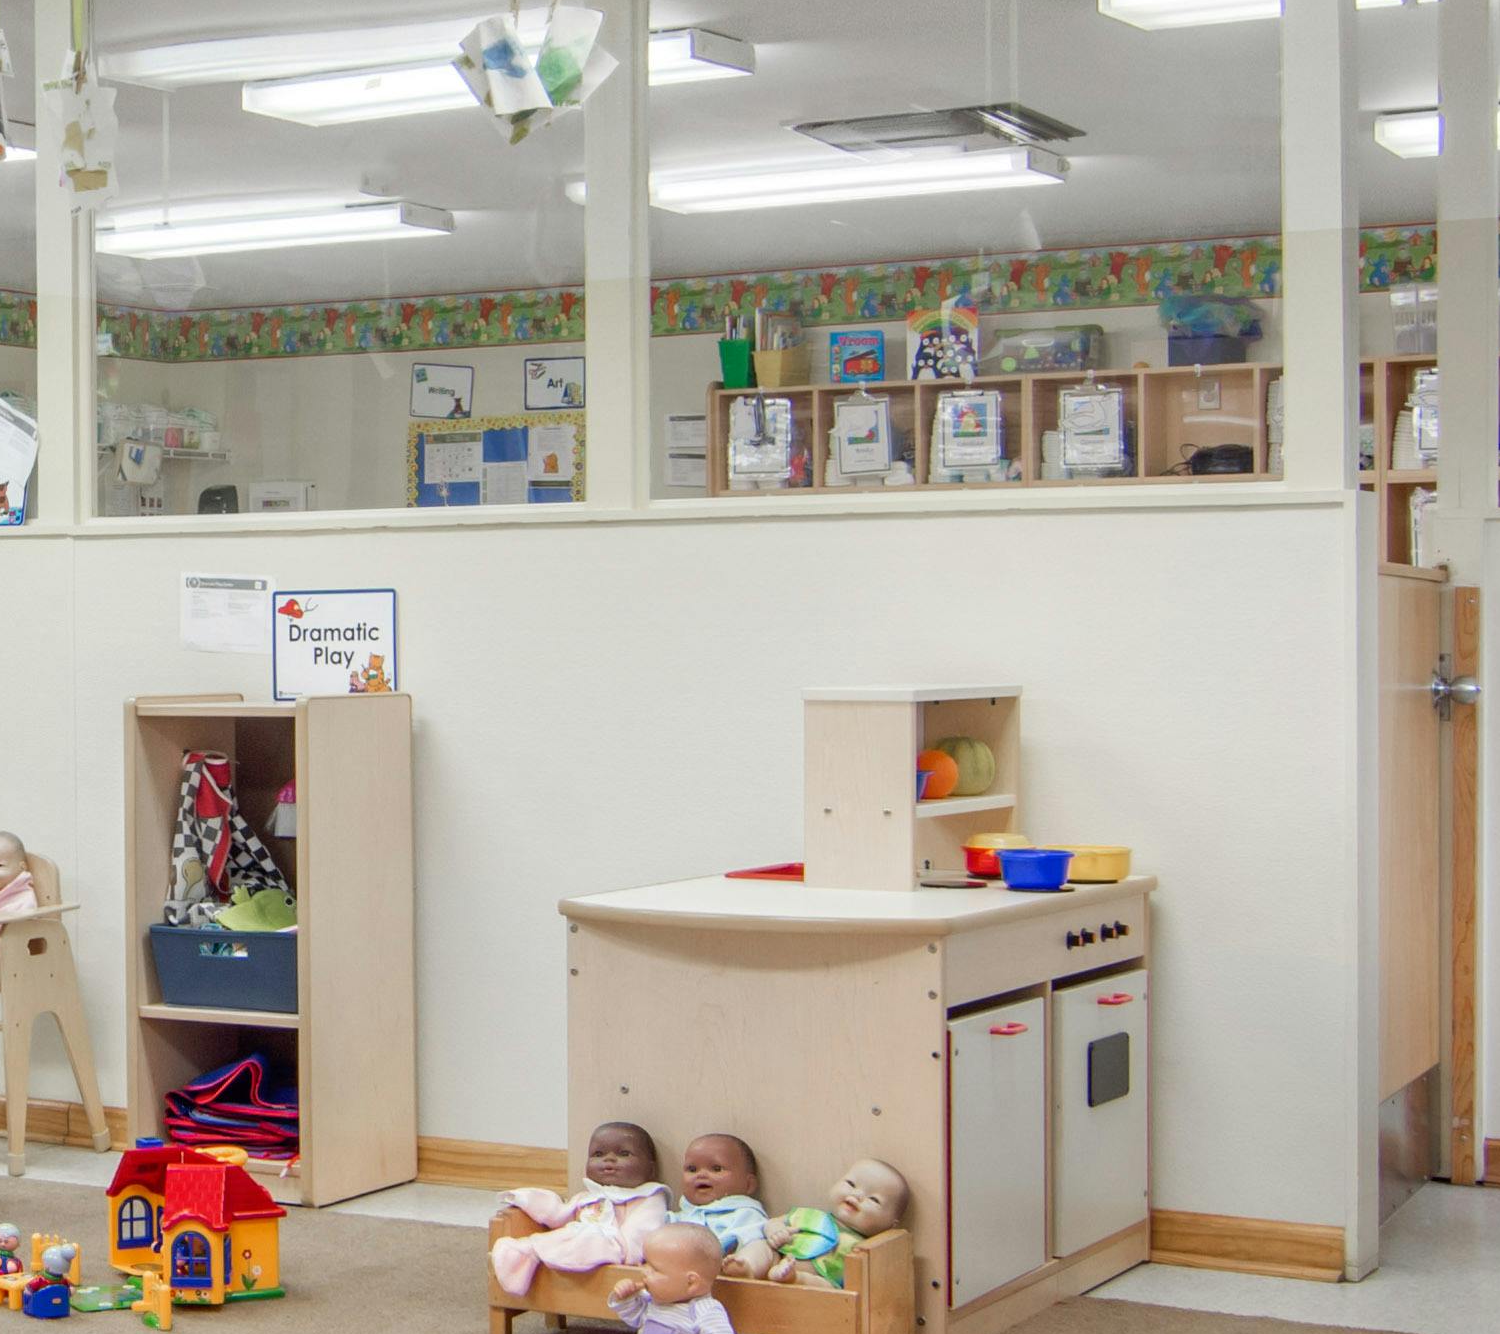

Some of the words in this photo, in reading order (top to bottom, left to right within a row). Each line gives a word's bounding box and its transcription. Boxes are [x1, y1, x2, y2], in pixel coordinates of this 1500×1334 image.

[428, 385, 456, 398] Writing
[546, 377, 565, 389] Art
[288, 622, 380, 643] Dramatic
[313, 646, 355, 669] Play
